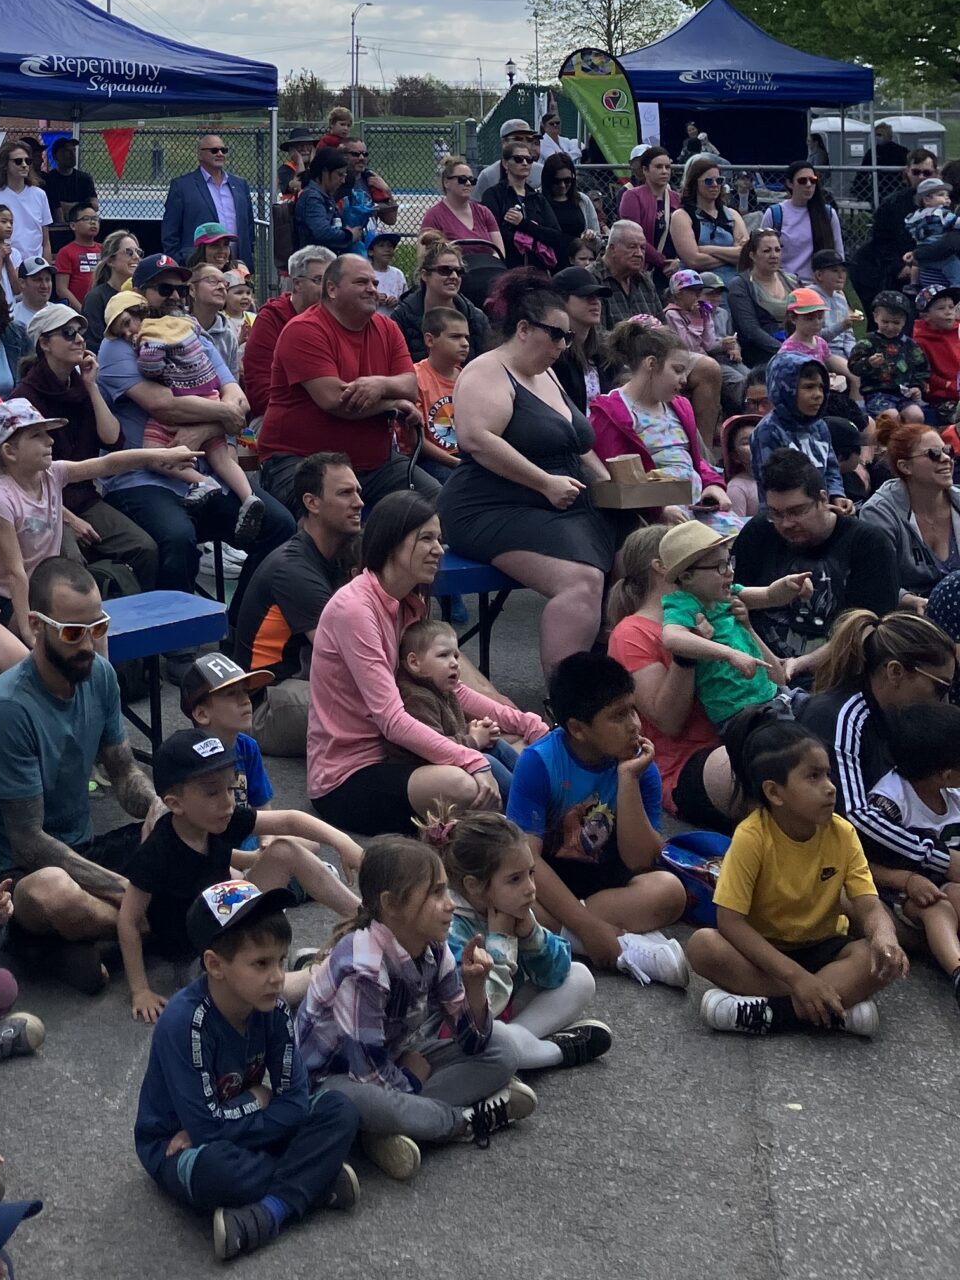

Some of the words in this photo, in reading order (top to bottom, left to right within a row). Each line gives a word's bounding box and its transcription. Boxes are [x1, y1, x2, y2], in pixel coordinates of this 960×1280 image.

[52, 54, 161, 81] Repentigny
[700, 69, 774, 84] Repentigny
[86, 75, 167, 98] S'épanouir
[428, 396, 450, 422] NORTH
[206, 658, 242, 679] FL
